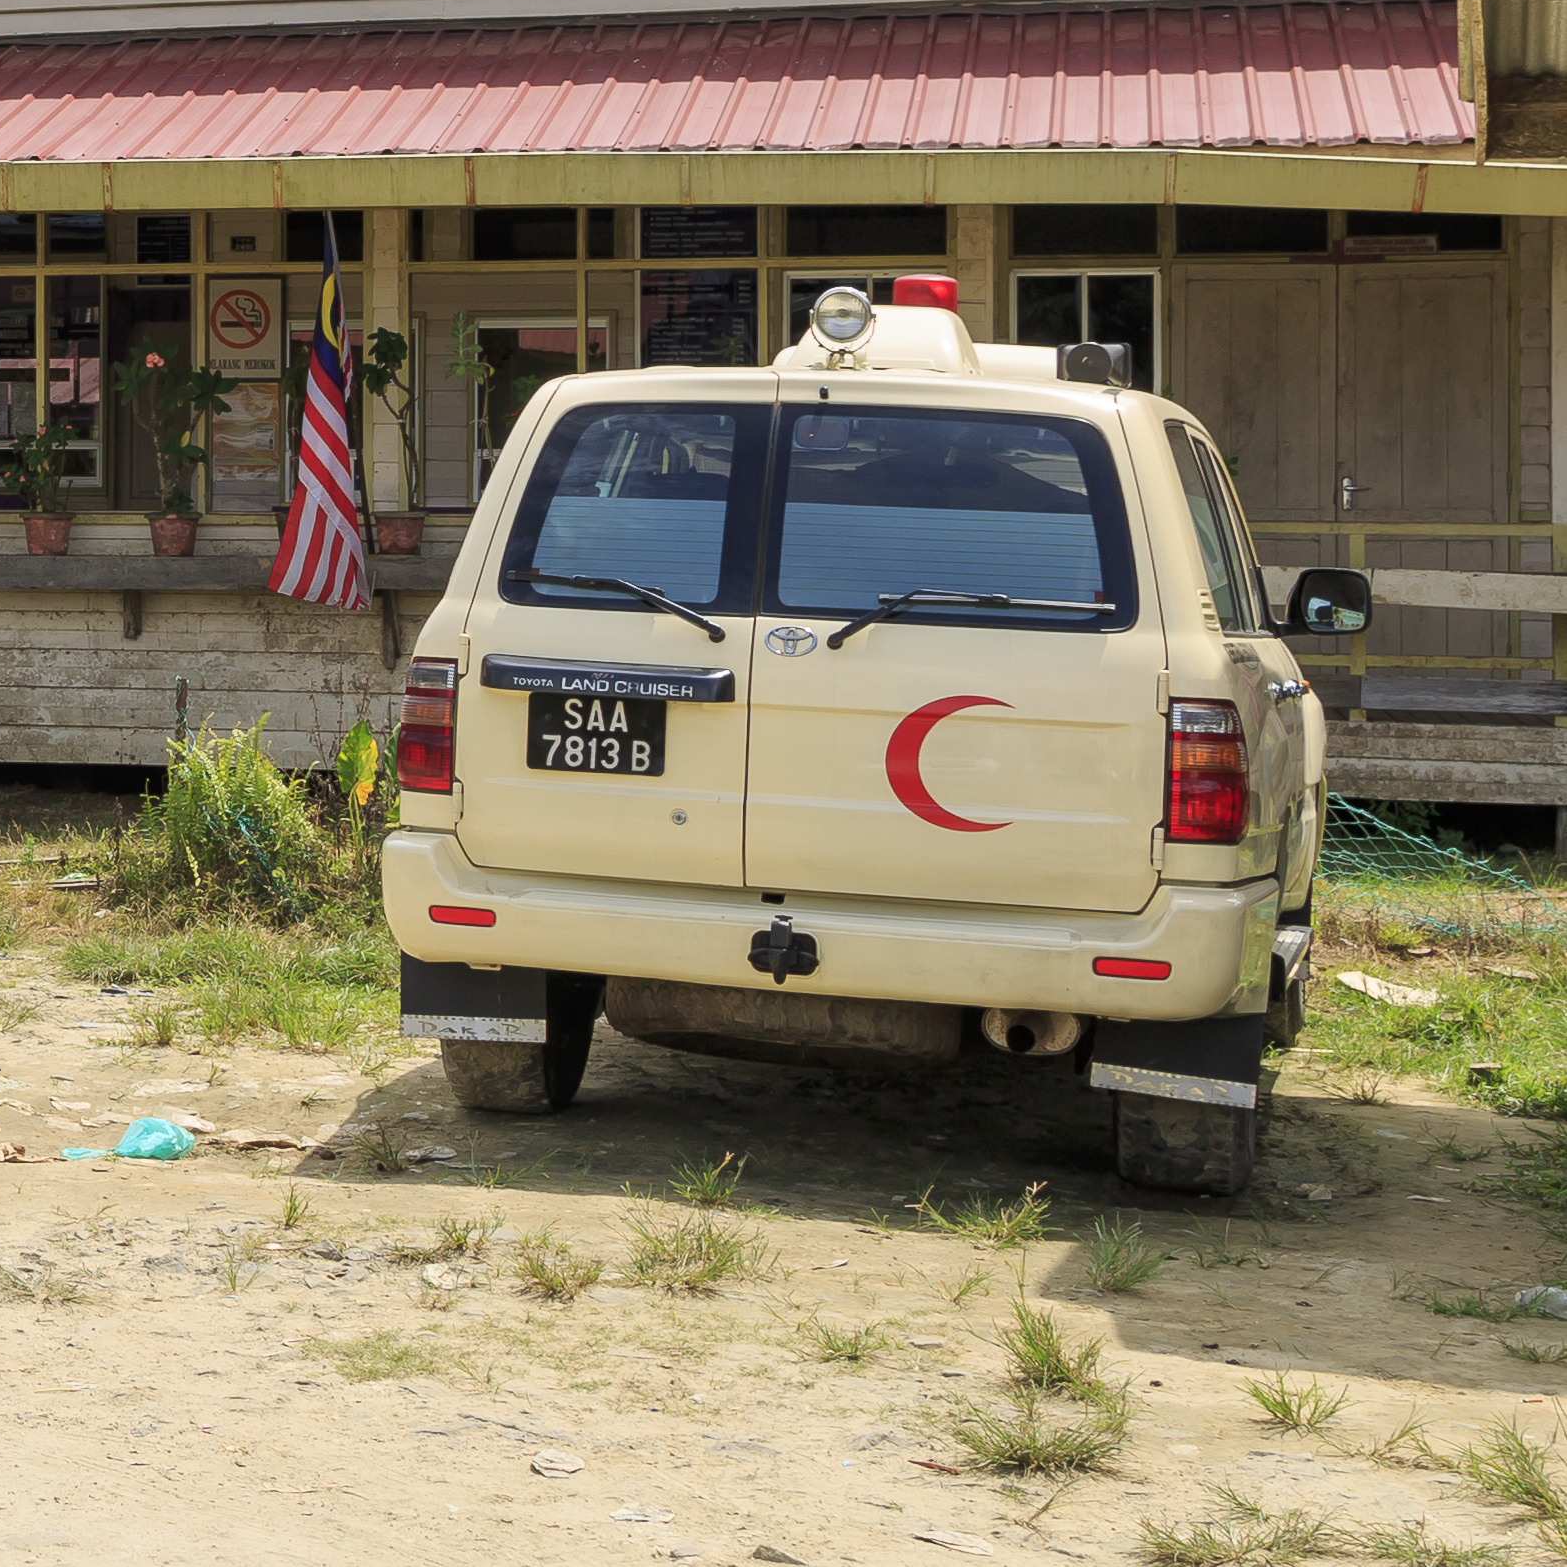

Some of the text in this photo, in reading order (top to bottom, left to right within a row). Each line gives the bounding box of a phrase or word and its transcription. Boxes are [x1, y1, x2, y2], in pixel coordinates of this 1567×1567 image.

[513, 676, 694, 697] TOYOTA LAND CRUISER
[564, 698, 628, 733] SAA
[542, 734, 651, 772] 7813 B
